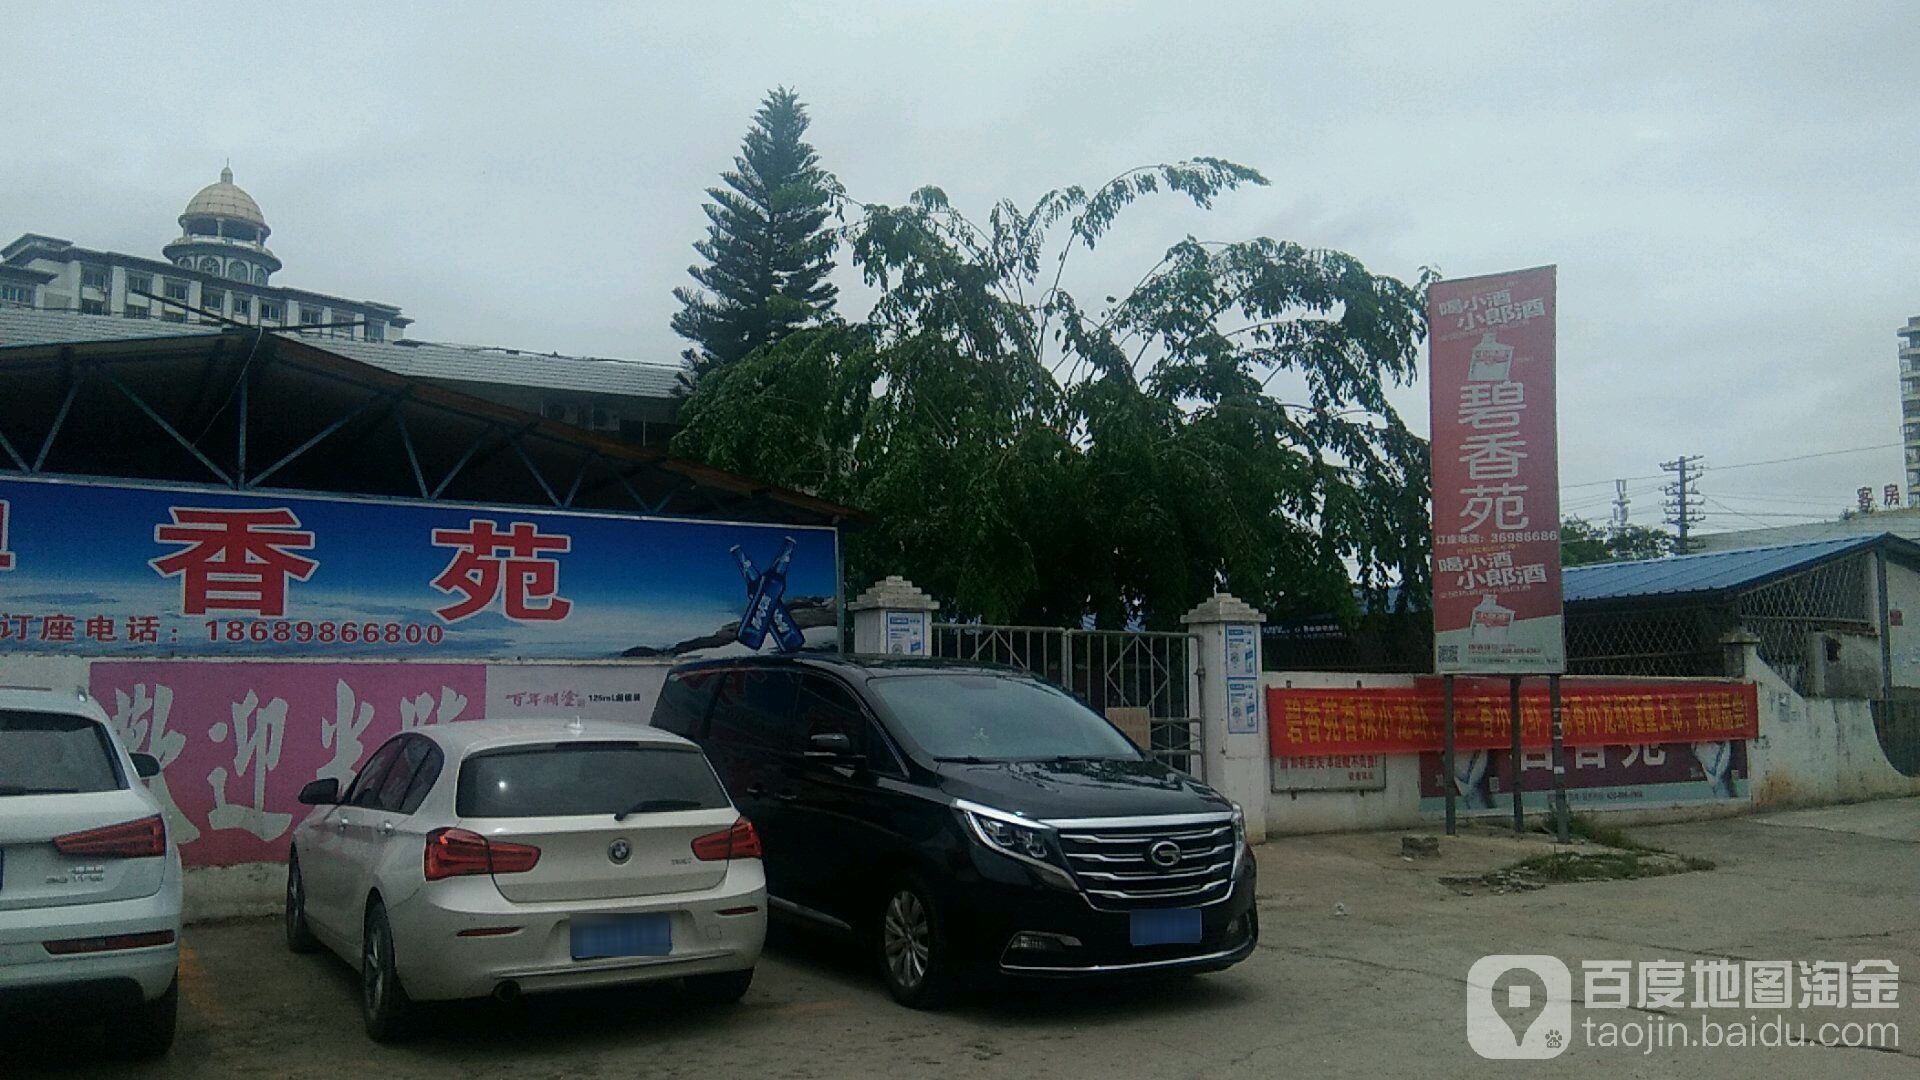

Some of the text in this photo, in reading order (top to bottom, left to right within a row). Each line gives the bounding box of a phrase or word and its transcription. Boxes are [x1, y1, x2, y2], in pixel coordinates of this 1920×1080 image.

[1458, 380, 1529, 534] 碧香苑
[1857, 484, 1900, 514] 客房
[1438, 550, 1513, 573] 喝小酒
[1456, 563, 1547, 590] 小郎酒
